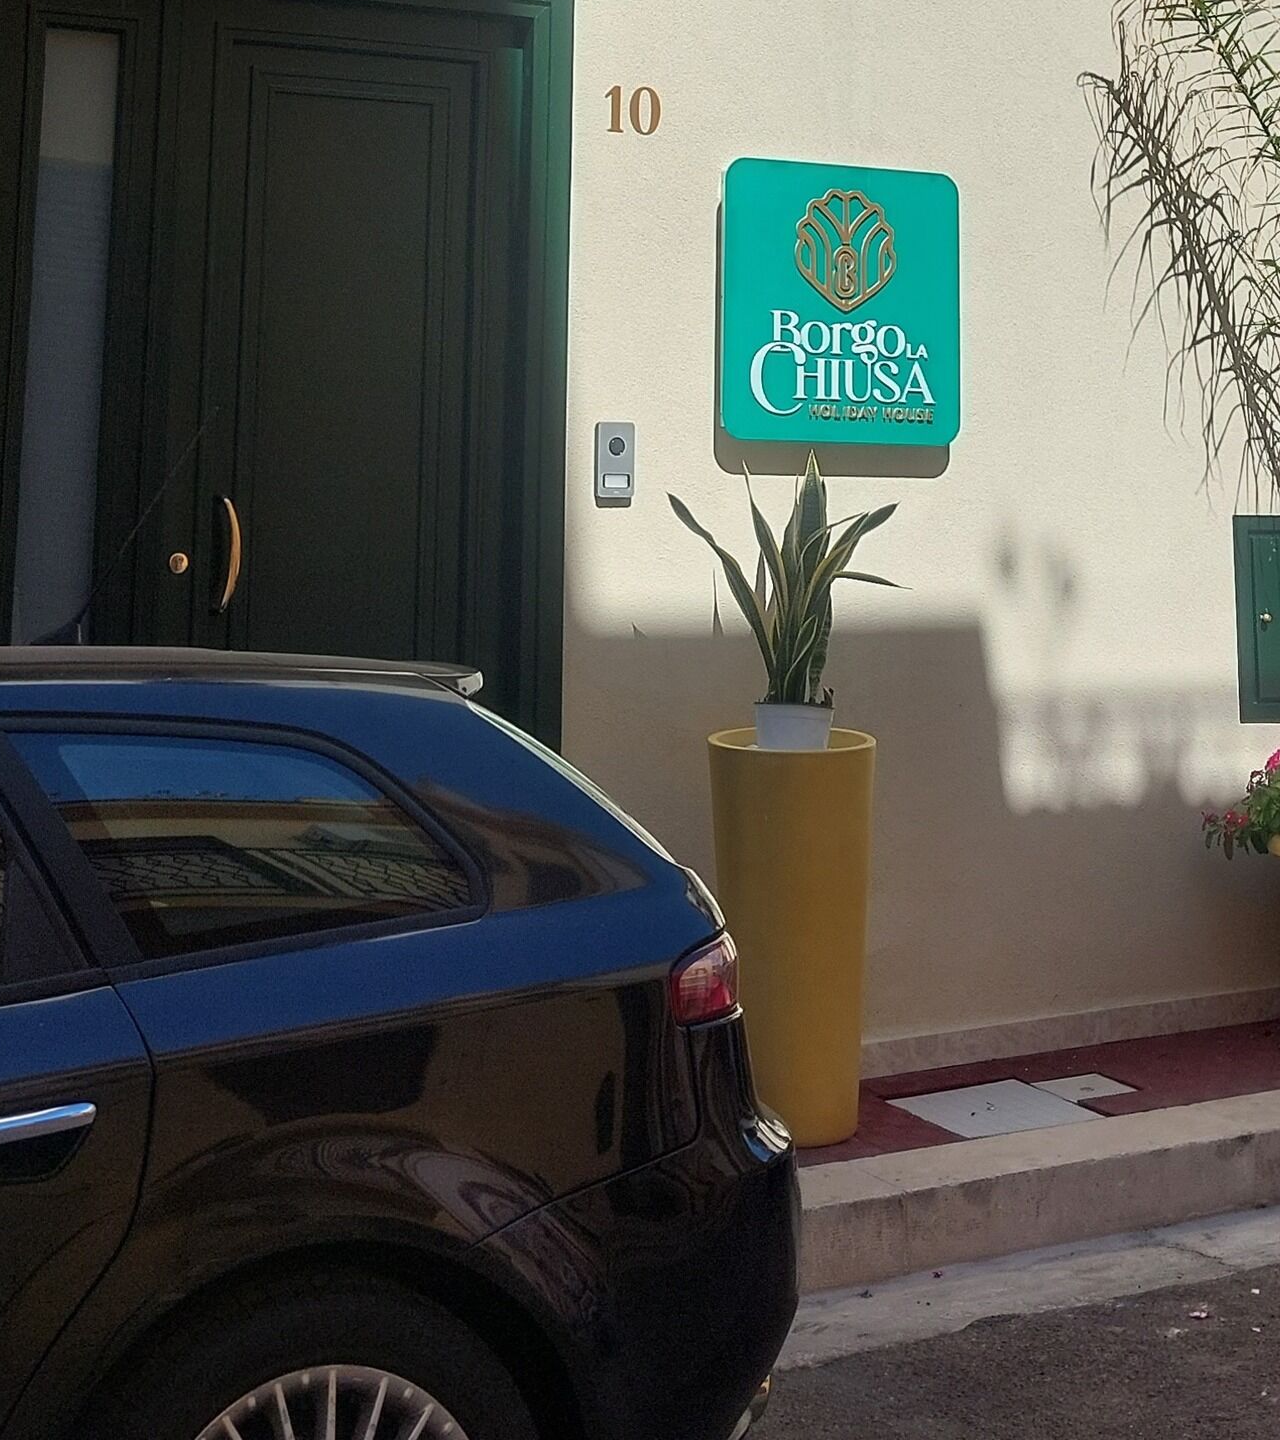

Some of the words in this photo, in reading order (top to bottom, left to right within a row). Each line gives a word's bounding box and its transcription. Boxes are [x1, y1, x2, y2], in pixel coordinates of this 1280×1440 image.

[604, 84, 662, 136] 10
[770, 309, 907, 364] Borgo
[905, 343, 929, 359] LA
[750, 340, 937, 415] CHIUSA
[808, 403, 878, 421] HOLIDAY
[882, 406, 934, 424] HOUSE
